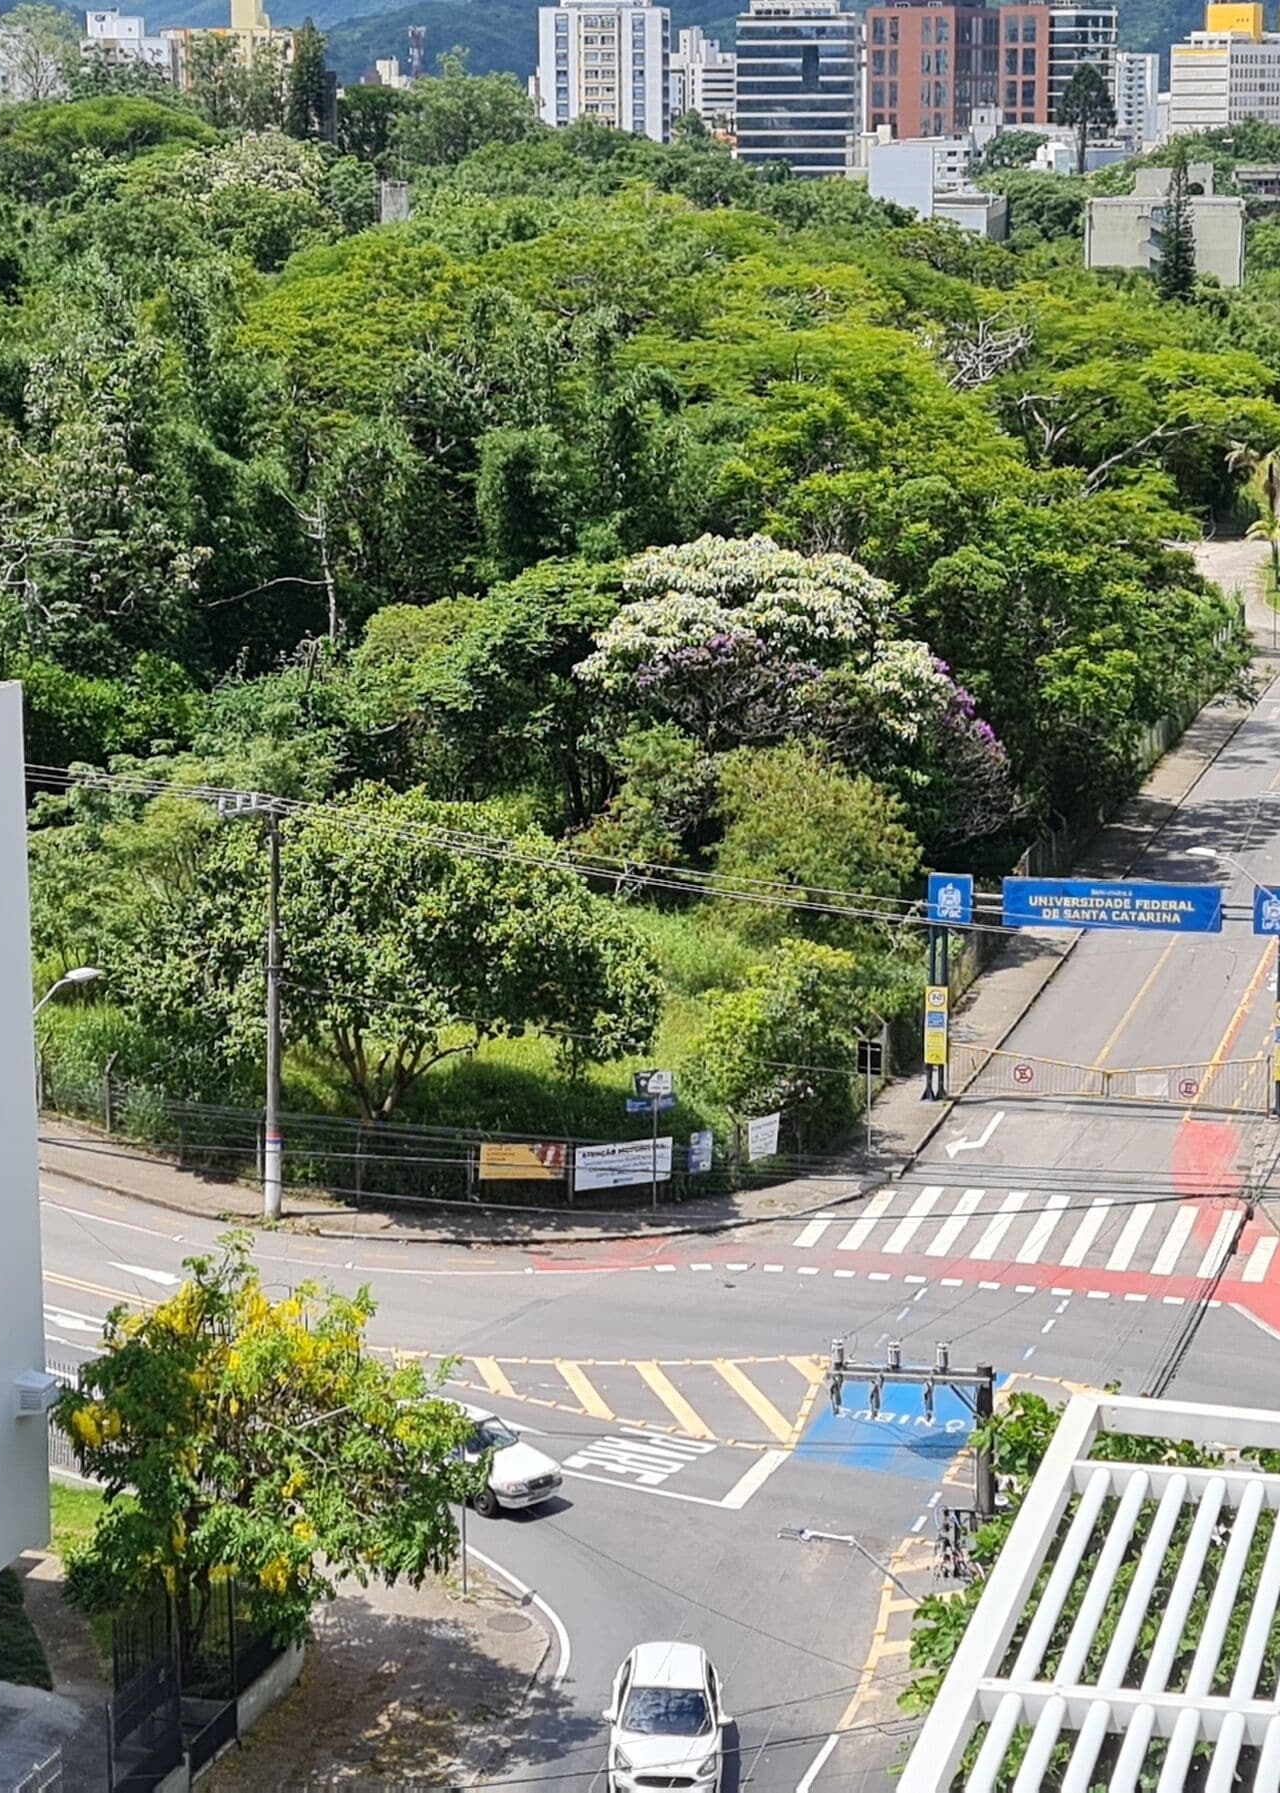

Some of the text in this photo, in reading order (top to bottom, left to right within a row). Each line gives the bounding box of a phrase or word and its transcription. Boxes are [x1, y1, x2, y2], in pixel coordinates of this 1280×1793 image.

[1028, 896, 1196, 912] UNIVERSIDADE FEDERAL
[1042, 908, 1181, 924] DE SANTA CATARINA
[561, 1427, 718, 1485] PARE
